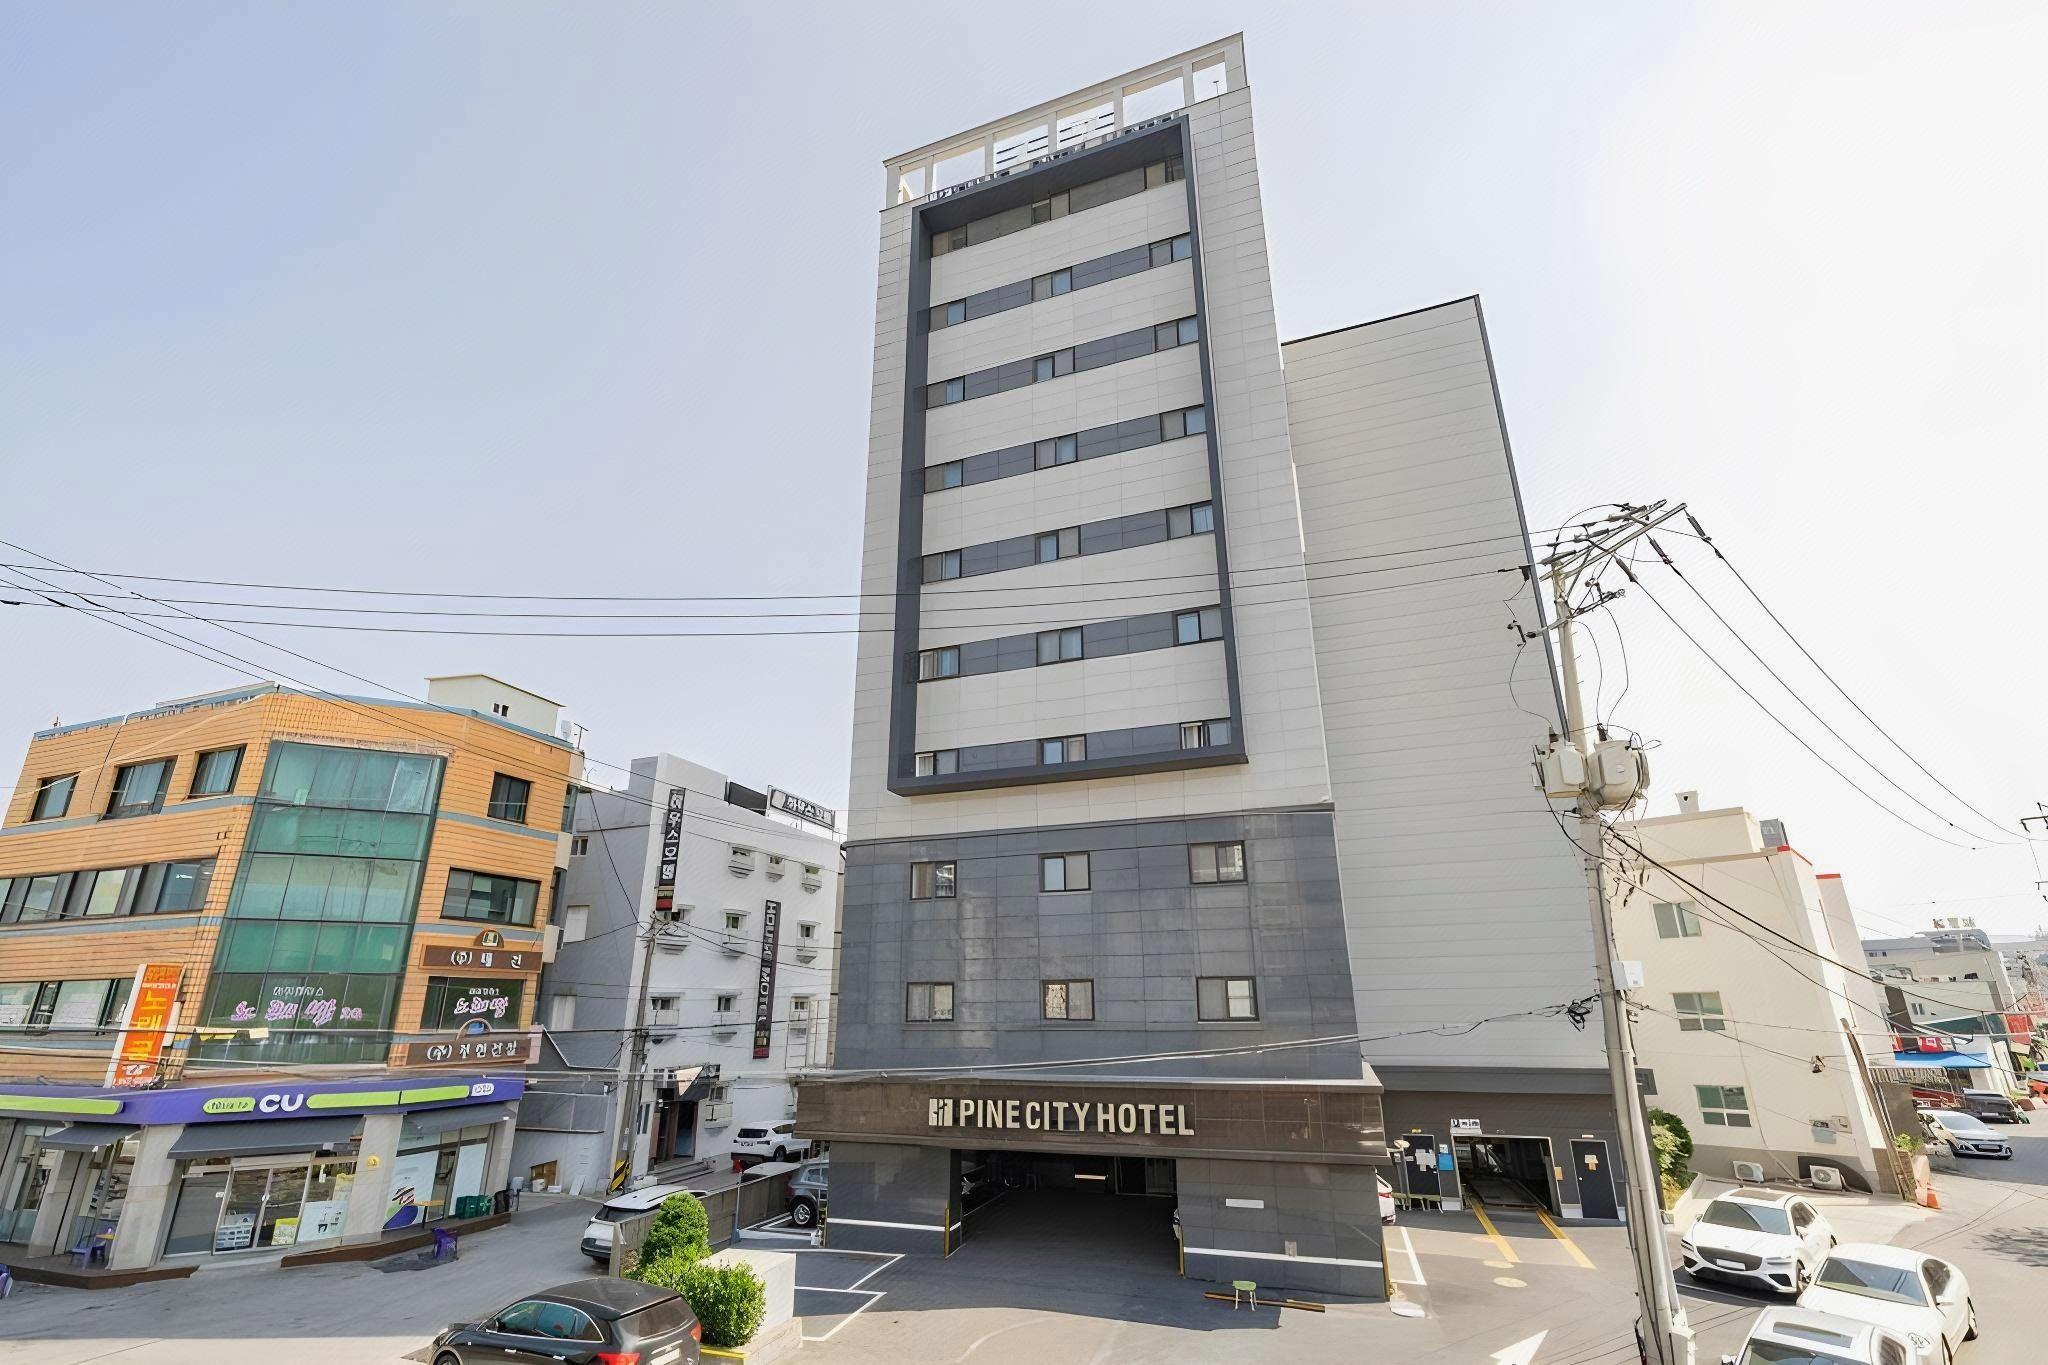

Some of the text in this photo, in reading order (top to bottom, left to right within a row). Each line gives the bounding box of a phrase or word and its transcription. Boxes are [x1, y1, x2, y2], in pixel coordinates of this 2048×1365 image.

[258, 1093, 304, 1113] CU
[959, 1099, 1195, 1136] PINE CITY HOTEL
